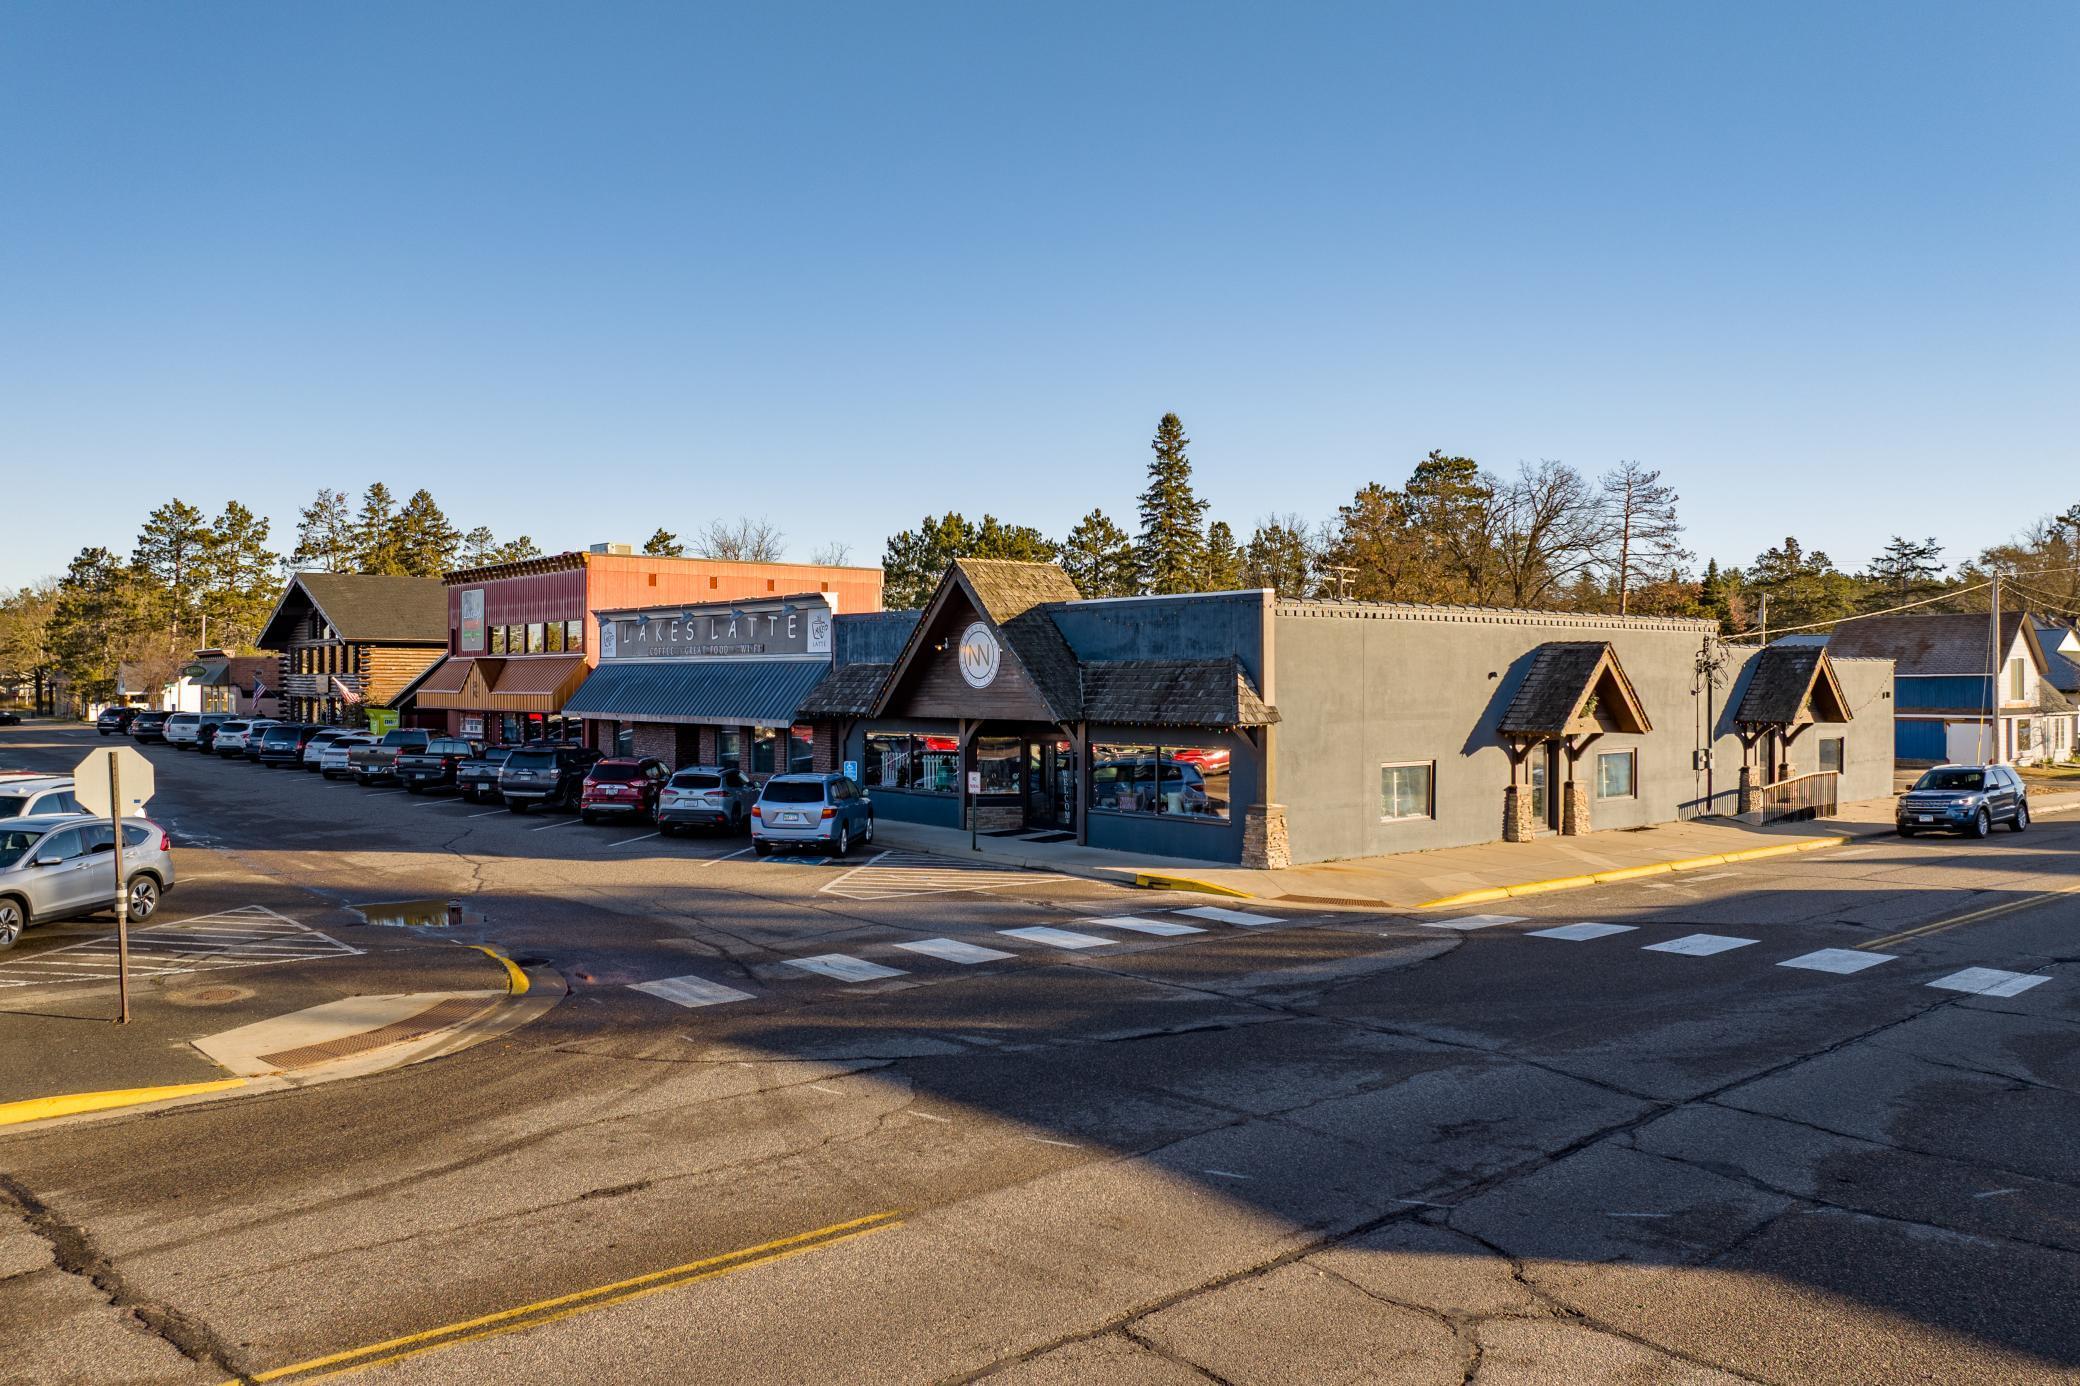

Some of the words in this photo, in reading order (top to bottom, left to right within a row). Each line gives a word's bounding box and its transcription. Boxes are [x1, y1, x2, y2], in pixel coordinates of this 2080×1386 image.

[623, 620, 695, 644] LAKES
[711, 614, 797, 640] LATTE
[649, 647, 674, 656] COFFEE
[684, 645, 706, 655] GREAT
[709, 644, 729, 655] FOOD
[1061, 769, 1071, 824] WELCOME
